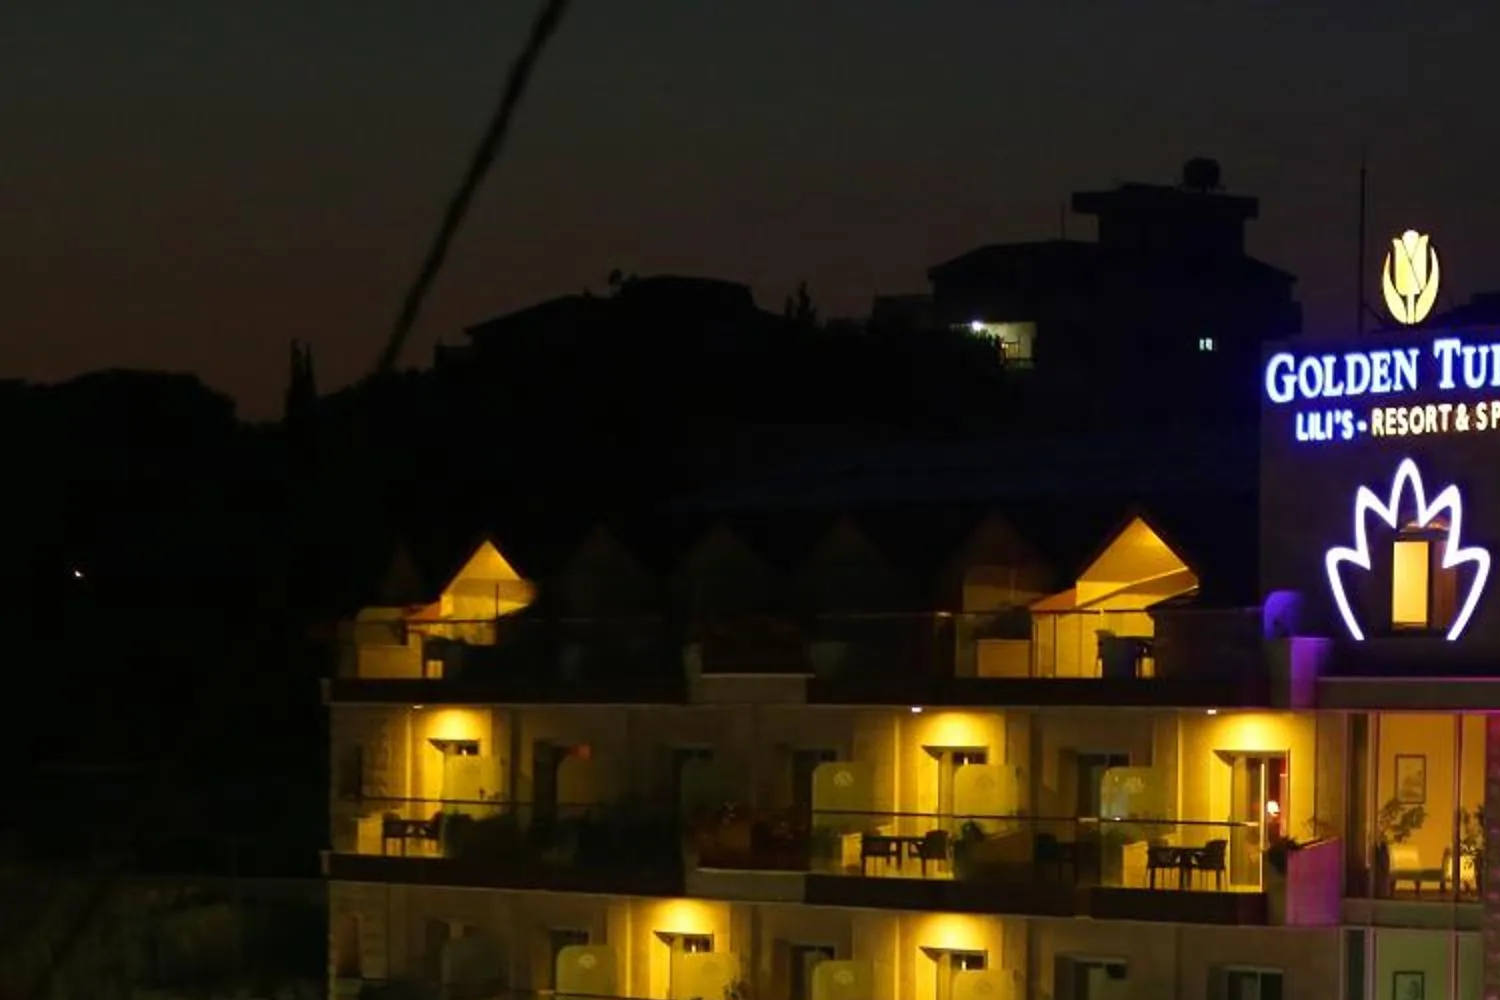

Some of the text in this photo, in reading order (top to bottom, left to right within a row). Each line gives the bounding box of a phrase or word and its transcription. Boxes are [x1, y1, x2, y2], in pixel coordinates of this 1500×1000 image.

[1265, 348, 1420, 404] GOLDEN
[1371, 403, 1453, 437] RESORT
[1454, 402, 1470, 432] &
